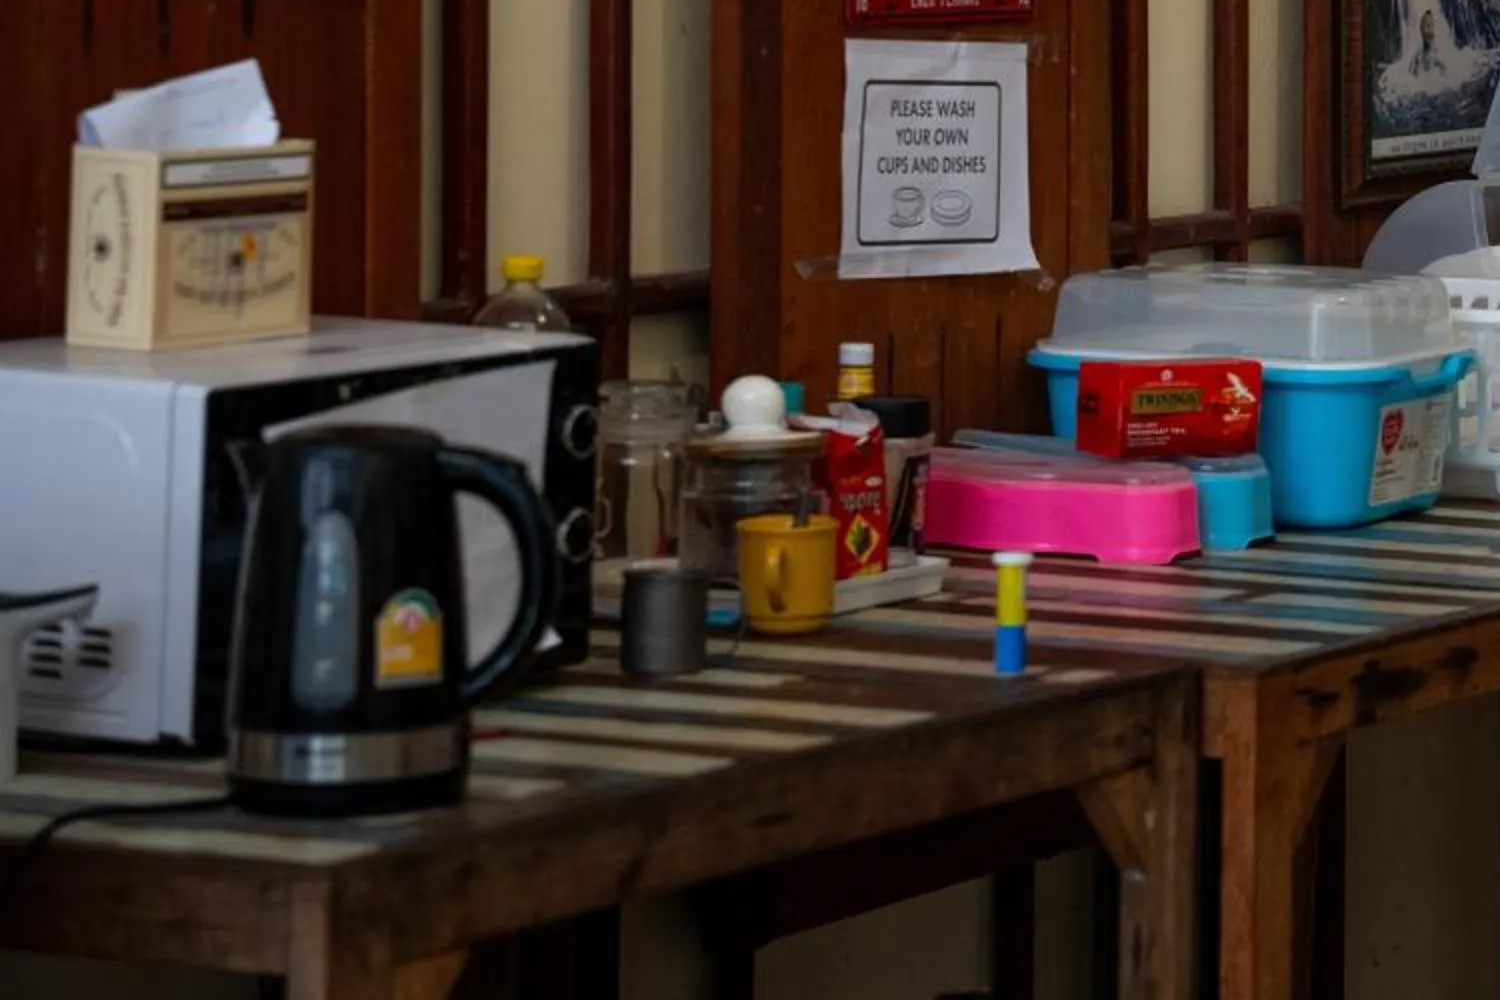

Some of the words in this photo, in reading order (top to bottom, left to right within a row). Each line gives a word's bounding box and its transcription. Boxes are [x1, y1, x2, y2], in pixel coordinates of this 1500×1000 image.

[890, 99, 933, 118] PLEASE
[936, 99, 975, 118] WASH
[895, 127, 931, 146] YOUR
[934, 127, 969, 146] OWN
[877, 155, 908, 175] CUPS
[911, 156, 939, 175] AND
[942, 156, 987, 175] DISHES
